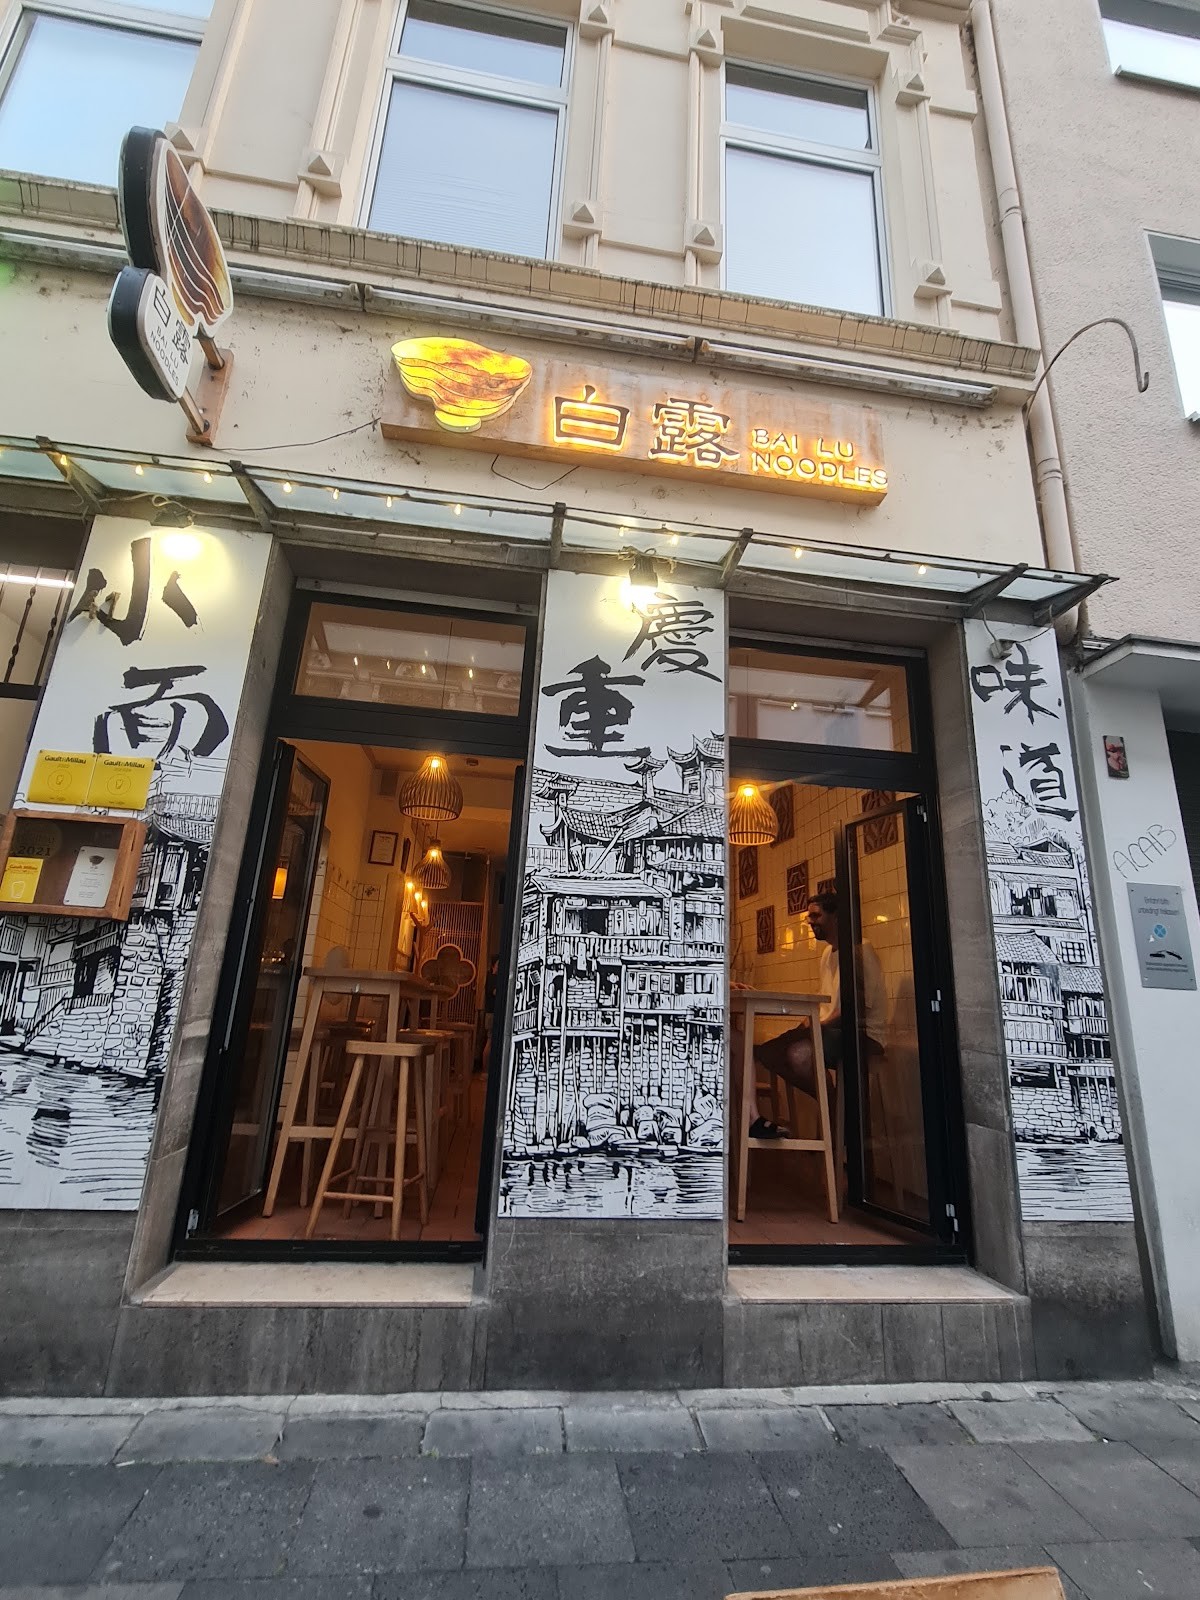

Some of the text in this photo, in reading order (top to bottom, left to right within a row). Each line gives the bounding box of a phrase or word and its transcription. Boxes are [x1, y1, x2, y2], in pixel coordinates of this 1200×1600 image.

[153, 285, 191, 364] 白露
[156, 326, 179, 369] BAI LU
[150, 331, 179, 387] NOODLES
[551, 384, 740, 468] 白露
[752, 428, 854, 462] BAI LU
[751, 451, 888, 489] NOODLES
[18, 845, 51, 857] 2021
[1113, 824, 1177, 879] ACAB
